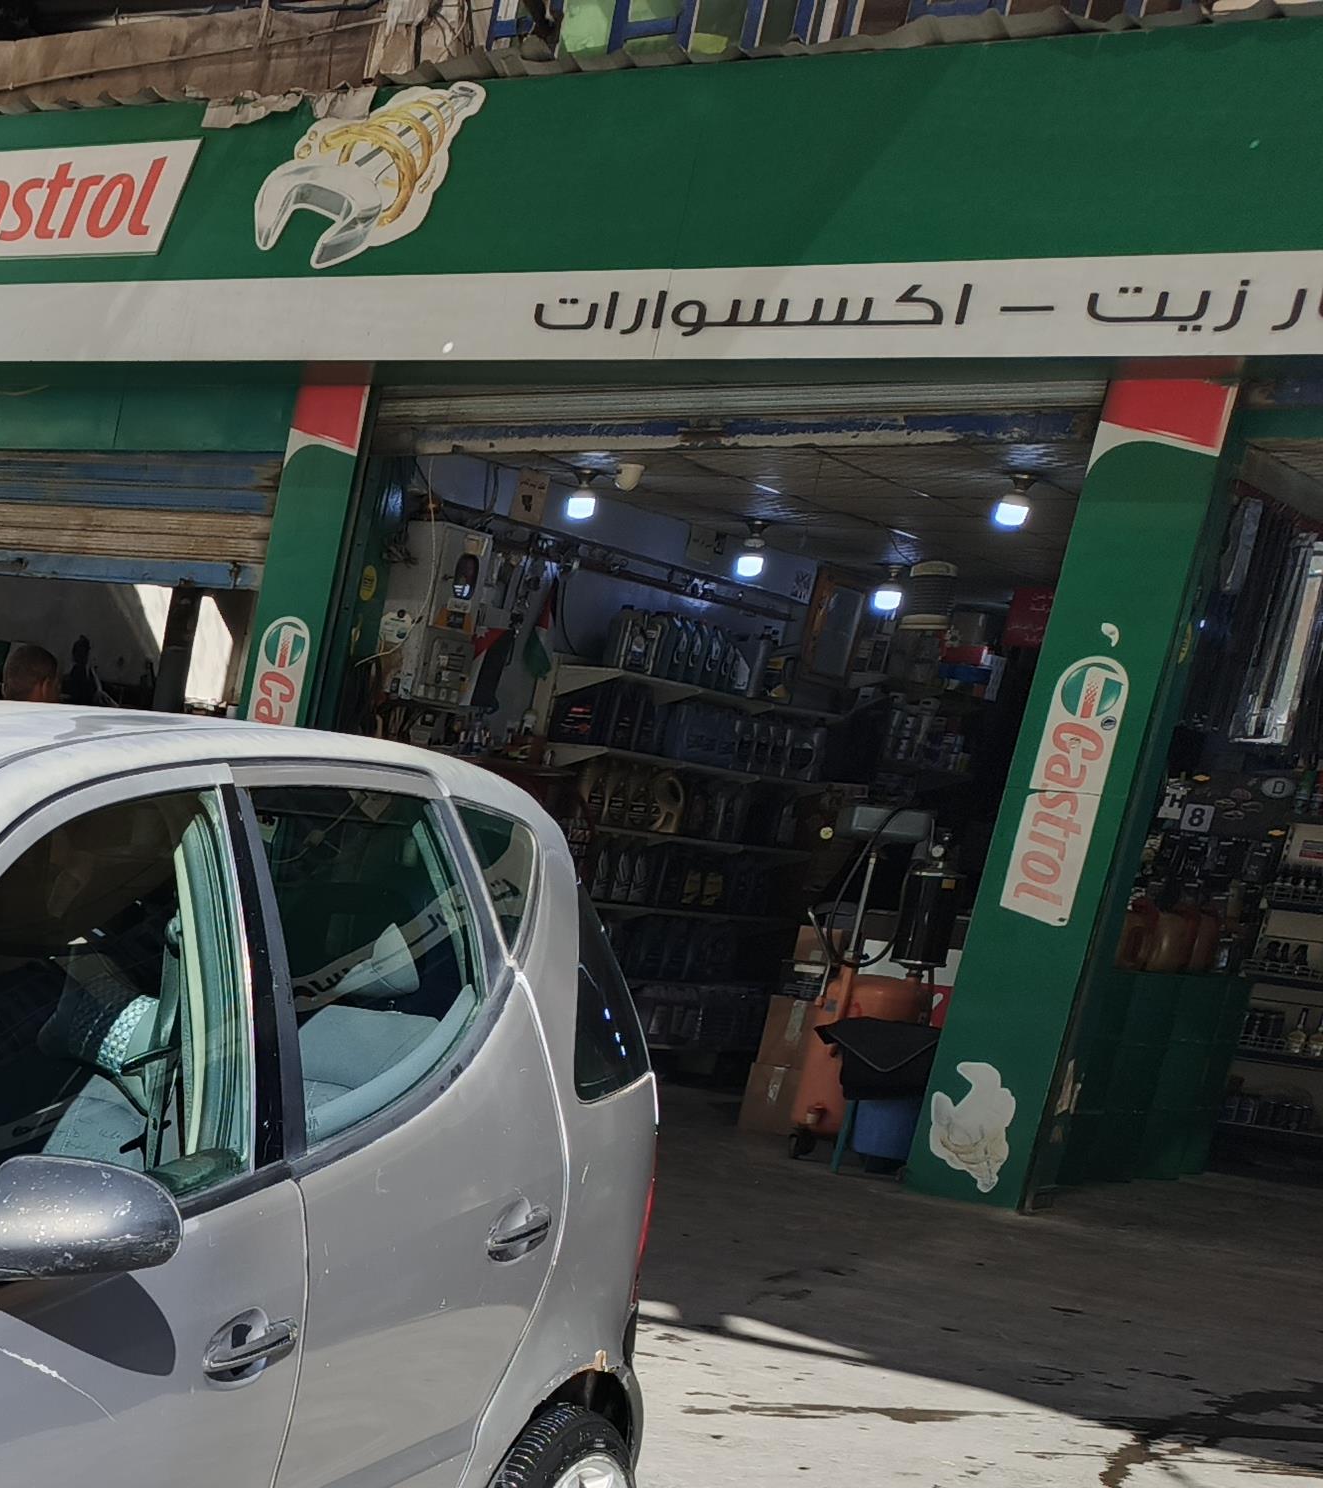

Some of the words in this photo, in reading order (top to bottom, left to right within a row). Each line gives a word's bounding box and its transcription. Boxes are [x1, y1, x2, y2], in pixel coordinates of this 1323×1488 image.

[533, 283, 973, 337] اكسسوارات
[1086, 279, 1251, 332] زيت
[1012, 722, 1105, 907] Castrol
